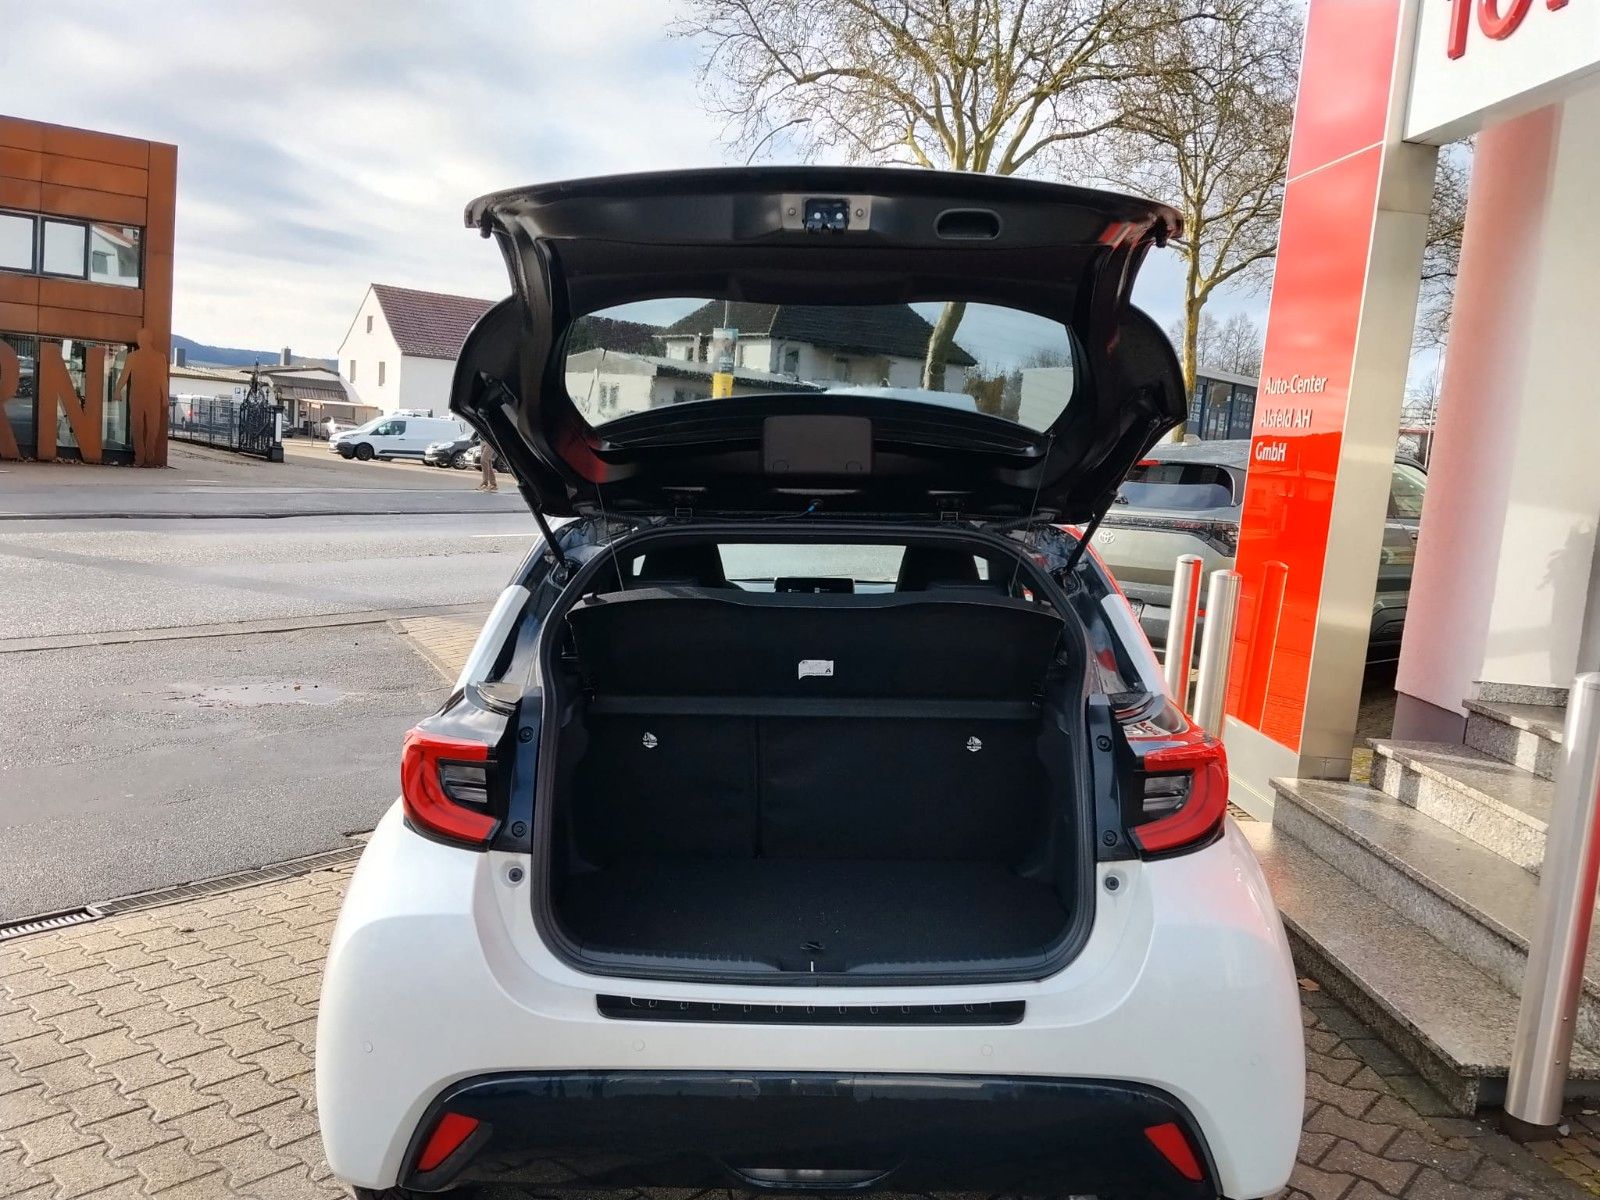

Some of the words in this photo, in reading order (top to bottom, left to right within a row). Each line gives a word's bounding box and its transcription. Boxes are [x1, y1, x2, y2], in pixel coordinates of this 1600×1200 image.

[1264, 374, 1328, 395] Auto-Center
[1260, 408, 1295, 428] Alsfeld
[1294, 409, 1313, 428] AH
[1255, 441, 1288, 462] GmbH
